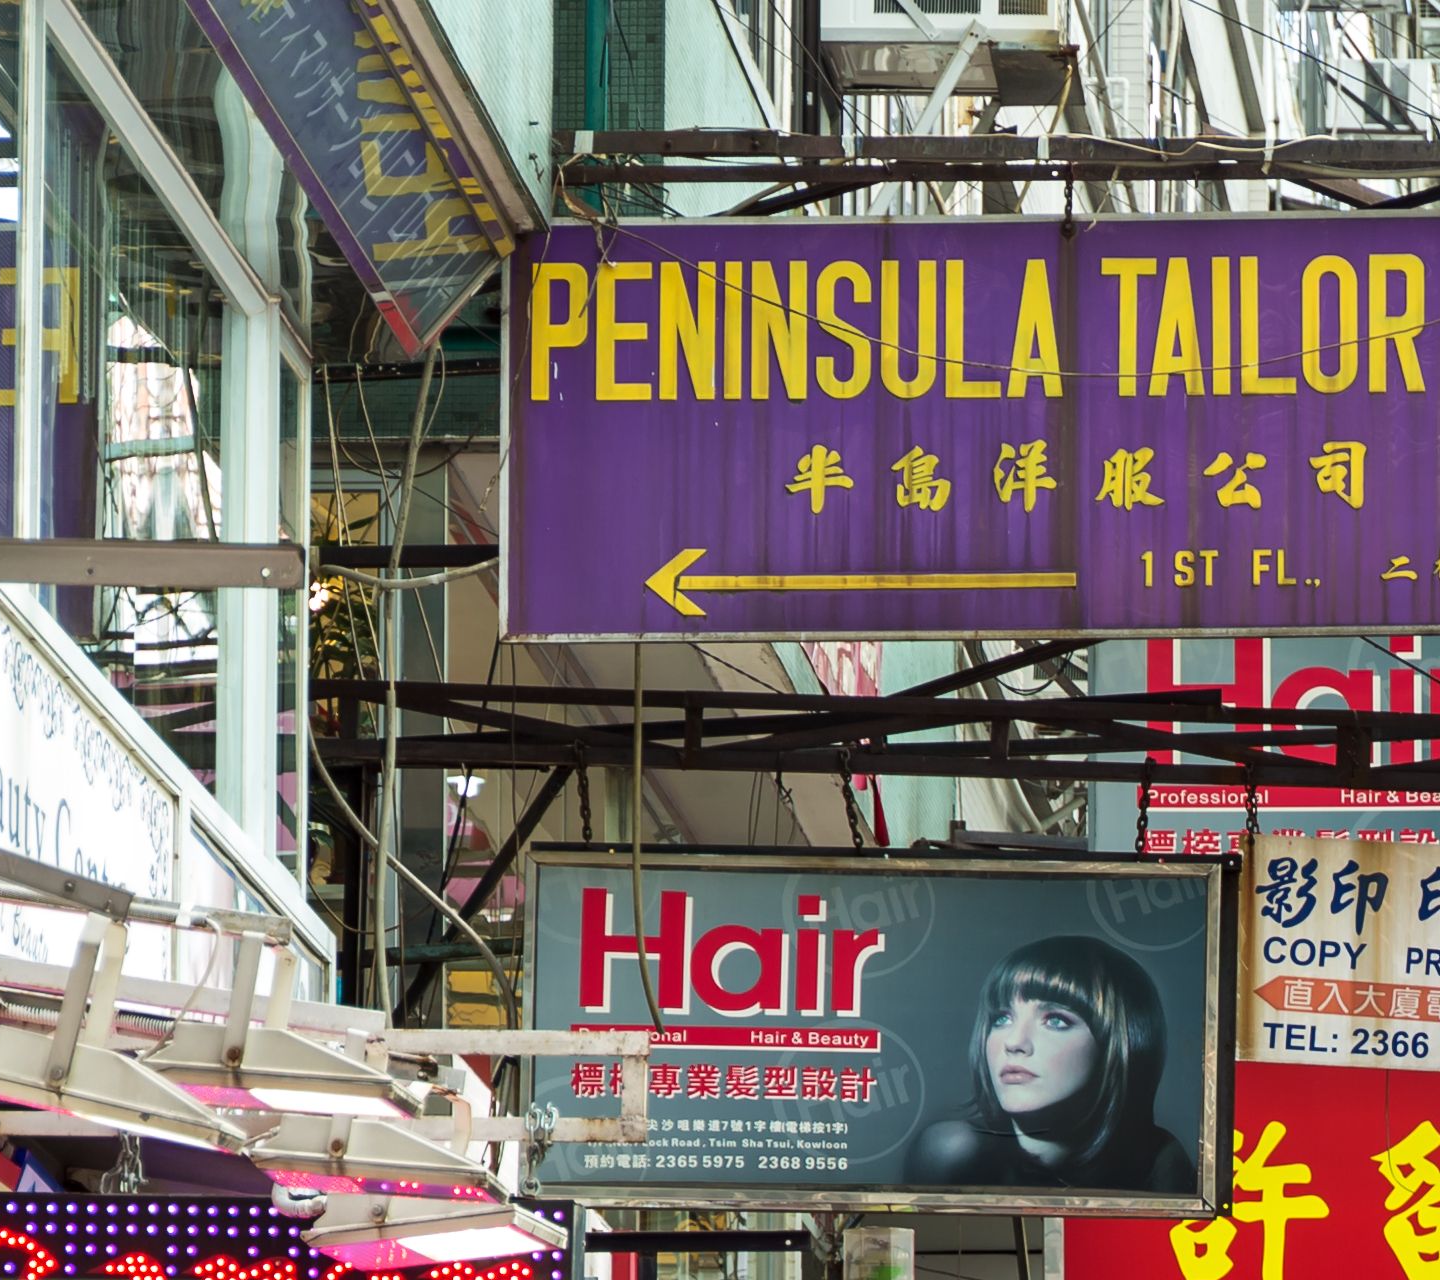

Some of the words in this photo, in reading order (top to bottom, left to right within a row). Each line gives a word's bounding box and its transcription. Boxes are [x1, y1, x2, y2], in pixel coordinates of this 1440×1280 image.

[530, 258, 1063, 401] PENINSULA
[1100, 251, 1426, 397] TAILOR
[783, 438, 1371, 516] 半島洋服公司
[1340, 790, 1383, 805] Hair
[1252, 855, 1389, 932] 影印
[578, 887, 885, 1018] Hair
[1263, 936, 1368, 975] COPY
[750, 1031, 789, 1045] Hair
[807, 1033, 870, 1048] Beauty
[1263, 1023, 1341, 1056] TEL:
[1350, 1028, 1431, 1061] 2366
[655, 1155, 698, 1169] 2365
[702, 1155, 746, 1169] 5975
[759, 1156, 801, 1170] 2368
[805, 1156, 849, 1171] 9556
[709, 1139, 737, 1149] Tsim
[742, 1139, 764, 1149] Sha
[797, 1140, 849, 1151] Kowloon
